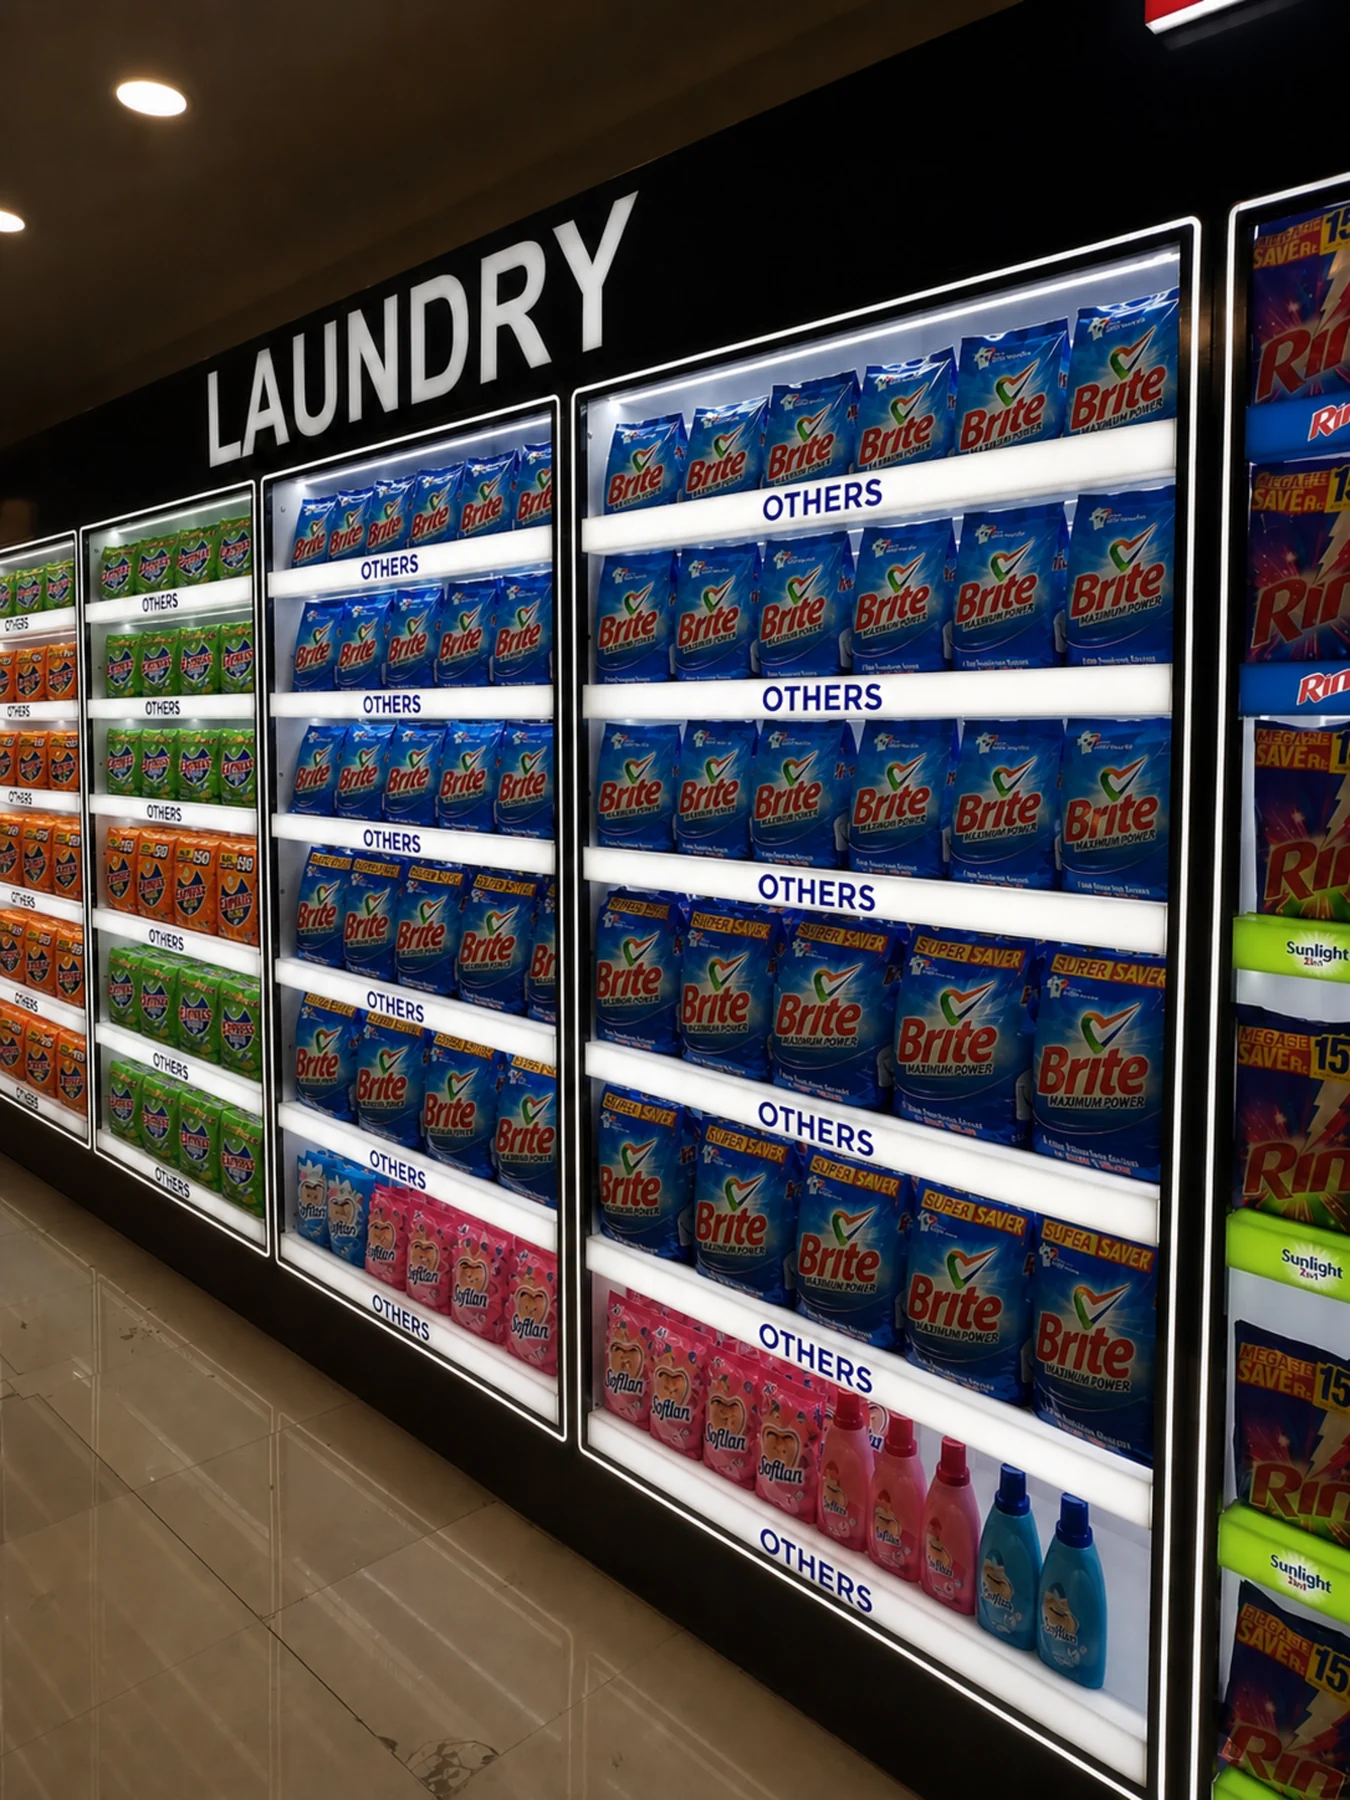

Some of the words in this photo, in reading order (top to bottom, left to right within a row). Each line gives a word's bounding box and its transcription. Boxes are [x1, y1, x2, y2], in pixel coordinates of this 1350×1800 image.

[207, 190, 639, 468] LAUNDRY
[1070, 365, 1166, 432] Brite
[960, 394, 1045, 451] Brite
[859, 414, 934, 466] Brite
[686, 449, 746, 492] Brite
[768, 432, 834, 482] Brite
[608, 462, 663, 505] Brite
[763, 478, 883, 521] OTHERS
[412, 506, 449, 539] Brite
[461, 495, 502, 530] Brite
[294, 533, 326, 561] Brite
[329, 523, 362, 556] Brite
[367, 516, 401, 548] Brite
[361, 554, 419, 580] OTHERS
[142, 593, 178, 612] OTHERS
[956, 574, 1037, 624] Brite
[1070, 563, 1165, 619] Brite
[761, 596, 825, 640] Brite
[855, 586, 930, 632] Brite
[496, 623, 541, 658] Brite
[598, 611, 658, 647] Brite
[678, 605, 739, 647] Brite
[296, 643, 331, 669] Brite
[339, 639, 376, 669] Brite
[388, 632, 427, 663] Brite
[439, 628, 482, 661] Brite
[145, 700, 180, 715] OTHERS
[363, 694, 421, 714] OTHERS
[763, 683, 883, 712] OTHERS
[296, 765, 330, 790] Brite
[338, 765, 378, 791] Brite
[387, 766, 429, 793] Brite
[440, 768, 485, 797] Brite
[499, 771, 547, 801] Brite
[598, 779, 662, 813] Brite
[679, 779, 739, 815] Brite
[754, 782, 821, 820] Brite
[853, 787, 930, 826] Brite
[955, 790, 1043, 834] Brite
[147, 804, 182, 822] OTHERS
[1064, 796, 1159, 842] Brite
[363, 829, 421, 853] OTHERS
[758, 874, 876, 912] OTHERS
[297, 902, 337, 929] Brite
[345, 912, 388, 940] Brite
[149, 929, 184, 951] OTHERS
[397, 921, 446, 949] Brite
[460, 932, 515, 963] Brite
[1286, 940, 1349, 962] Sunlight
[917, 937, 966, 962] SUPER
[971, 948, 1022, 969] SAVER
[597, 961, 662, 999] Brite
[367, 991, 424, 1023] OTHERS
[682, 985, 749, 1025] Brite
[776, 995, 862, 1037] Brite
[898, 1018, 997, 1064] Brite
[153, 1052, 188, 1080] OTHERS
[296, 1048, 339, 1077] Brite
[954, 1063, 993, 1075] POWER
[1037, 1046, 1149, 1096] Brite
[357, 1068, 407, 1101] Brite
[424, 1092, 475, 1128] Brite
[1102, 1095, 1144, 1108] POWER
[496, 1117, 554, 1154] Brite
[758, 1101, 874, 1157] OTHERS
[155, 1167, 190, 1198] OTHERS
[369, 1150, 426, 1189] OTHERS
[855, 1168, 898, 1197] SAVER
[600, 1167, 660, 1207] Brite
[696, 1202, 767, 1245] Brite
[974, 1207, 1025, 1236] SAVER
[799, 1234, 880, 1284] Brite
[1098, 1238, 1152, 1270] SAVER
[1282, 1248, 1343, 1279] Sunlight
[453, 1284, 487, 1308] Softlan
[908, 1274, 1002, 1332] Brite
[372, 1294, 430, 1341] OTHERS
[511, 1315, 548, 1340] Softlan
[962, 1330, 999, 1343] POWER
[1037, 1312, 1136, 1379] Brite
[759, 1323, 873, 1394] OTHERS
[1091, 1374, 1130, 1391] POWER
[705, 1422, 746, 1450] Softlan
[759, 1453, 802, 1485] Softlan
[760, 1529, 873, 1613] OTHERS
[1270, 1554, 1332, 1593] Sunlight
[1230, 1724, 1346, 1800] Rin
